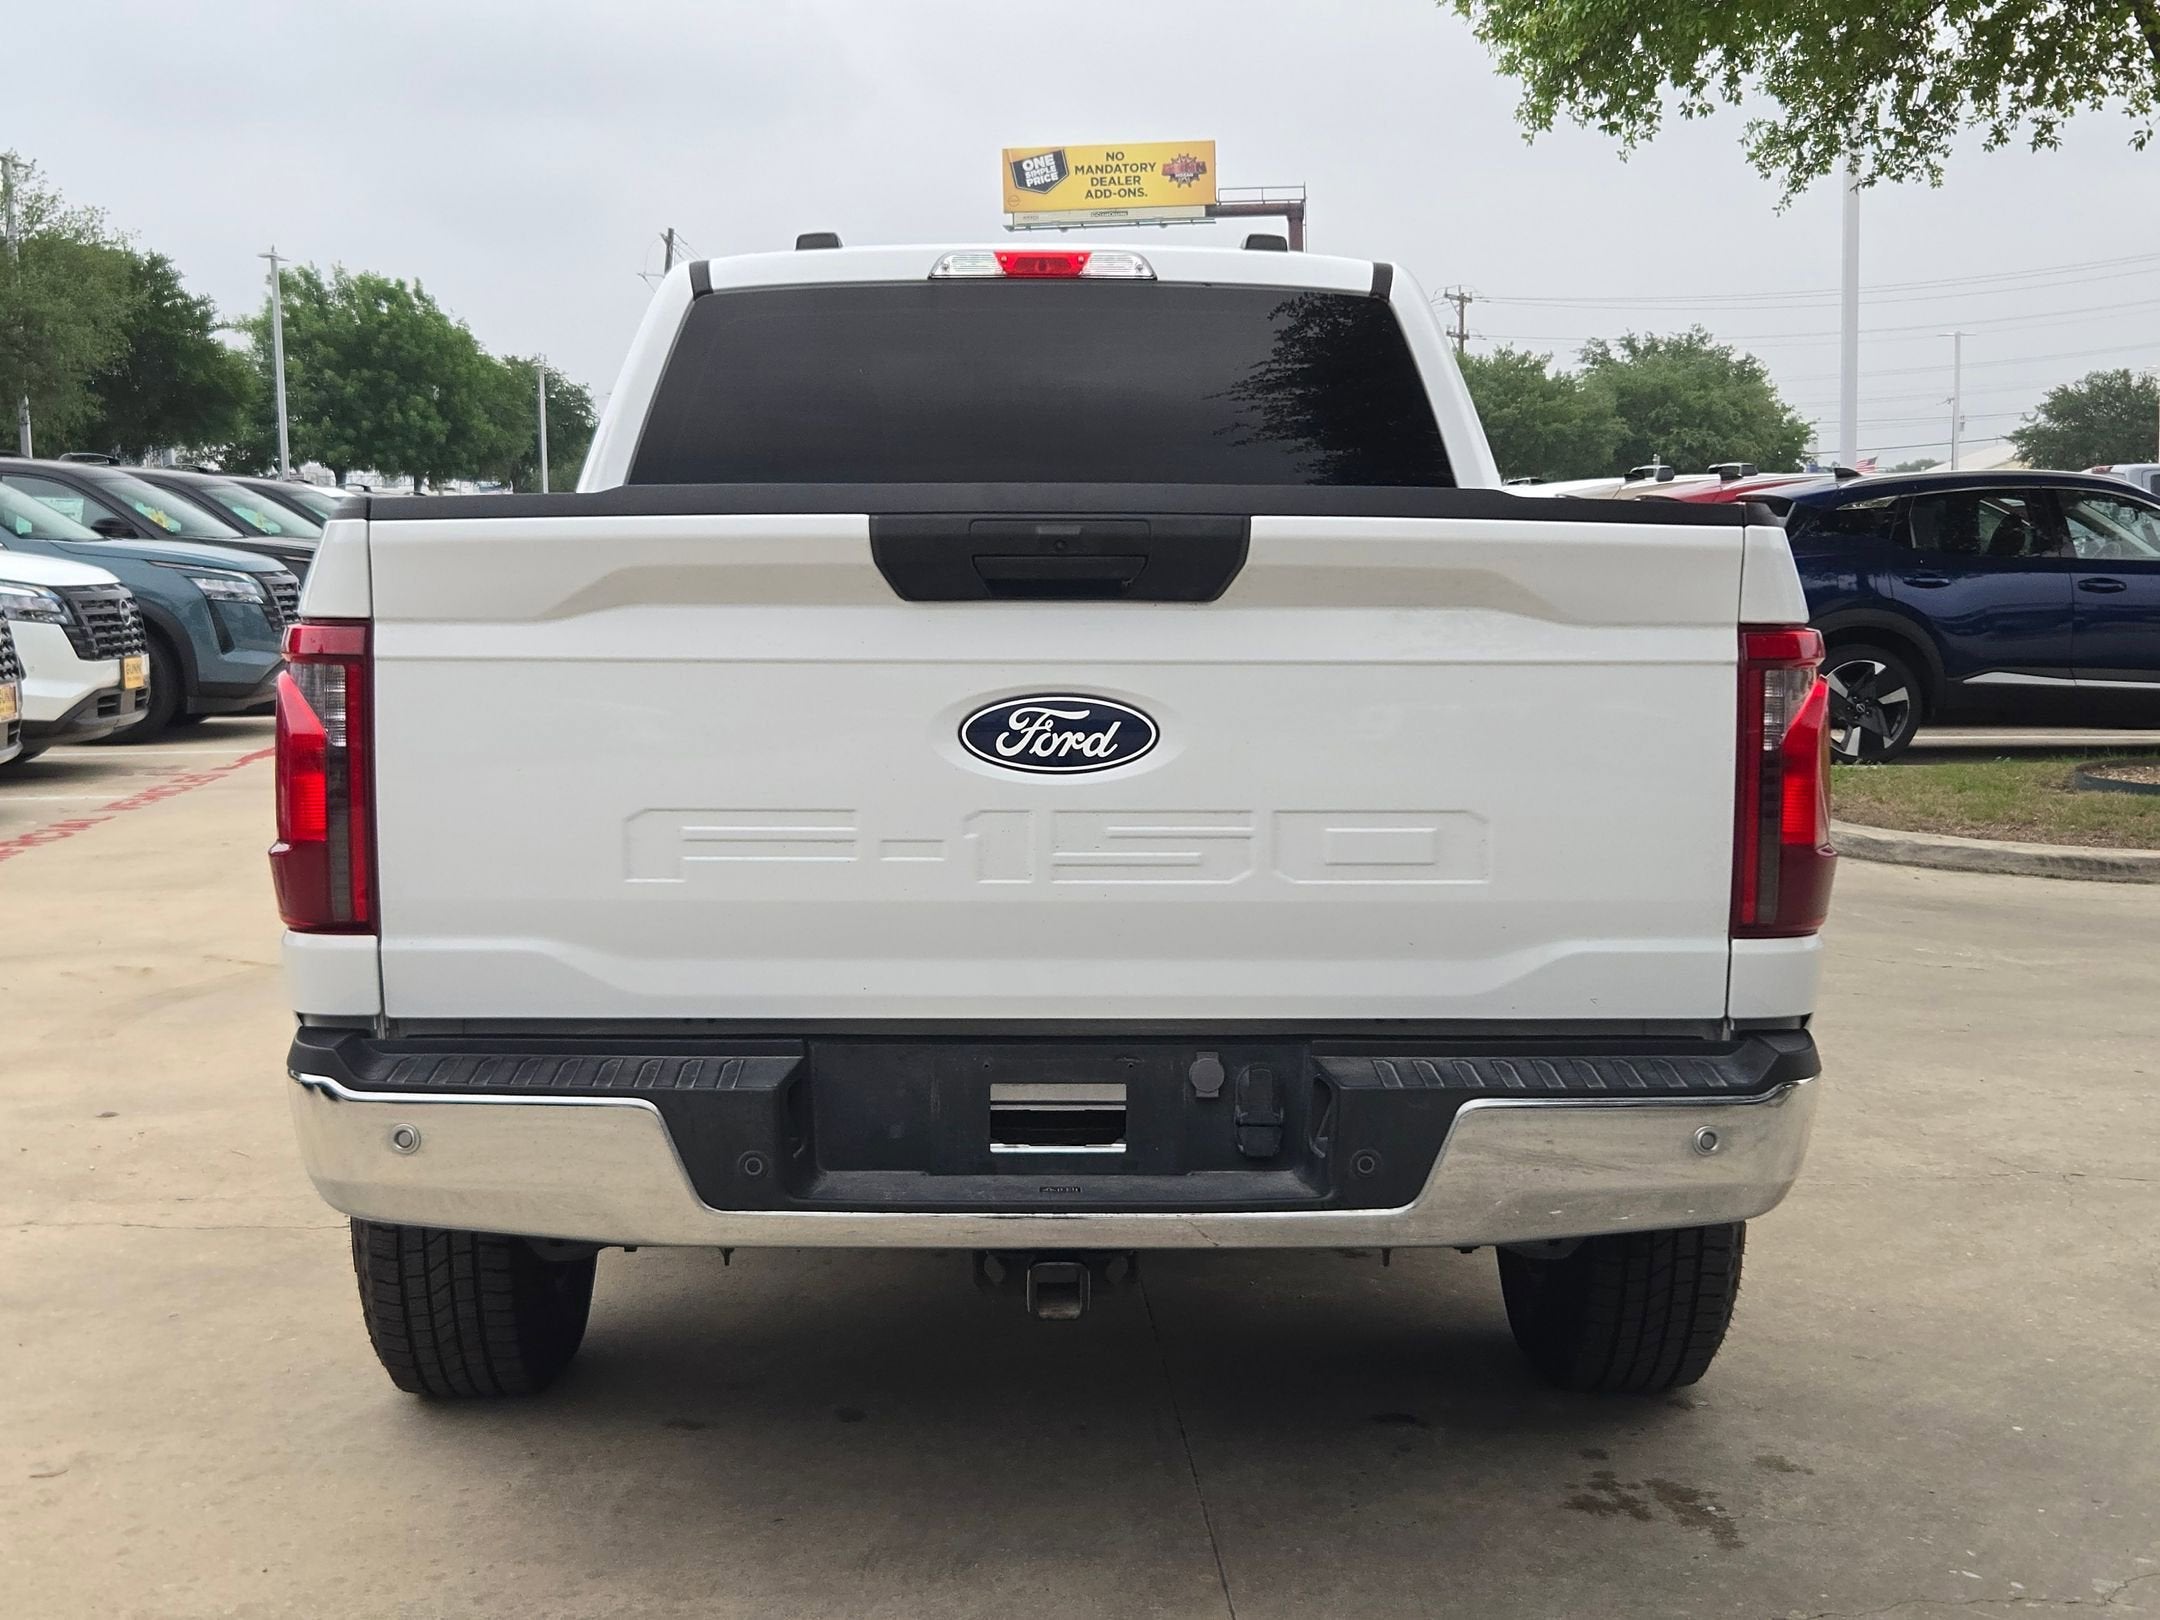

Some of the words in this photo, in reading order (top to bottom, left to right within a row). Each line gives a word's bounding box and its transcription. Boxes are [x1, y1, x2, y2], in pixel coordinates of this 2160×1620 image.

[1022, 153, 1055, 171] ONE
[1105, 151, 1125, 162] NO
[1025, 164, 1057, 179] SIMPLE
[1074, 162, 1156, 175] MANDATORY
[1026, 171, 1059, 187] PRICE
[1090, 175, 1142, 187] DEALER
[1084, 187, 1149, 200] ADD-ONS.
[995, 707, 1121, 757] Ford
[623, 808, 1491, 886] F-150
